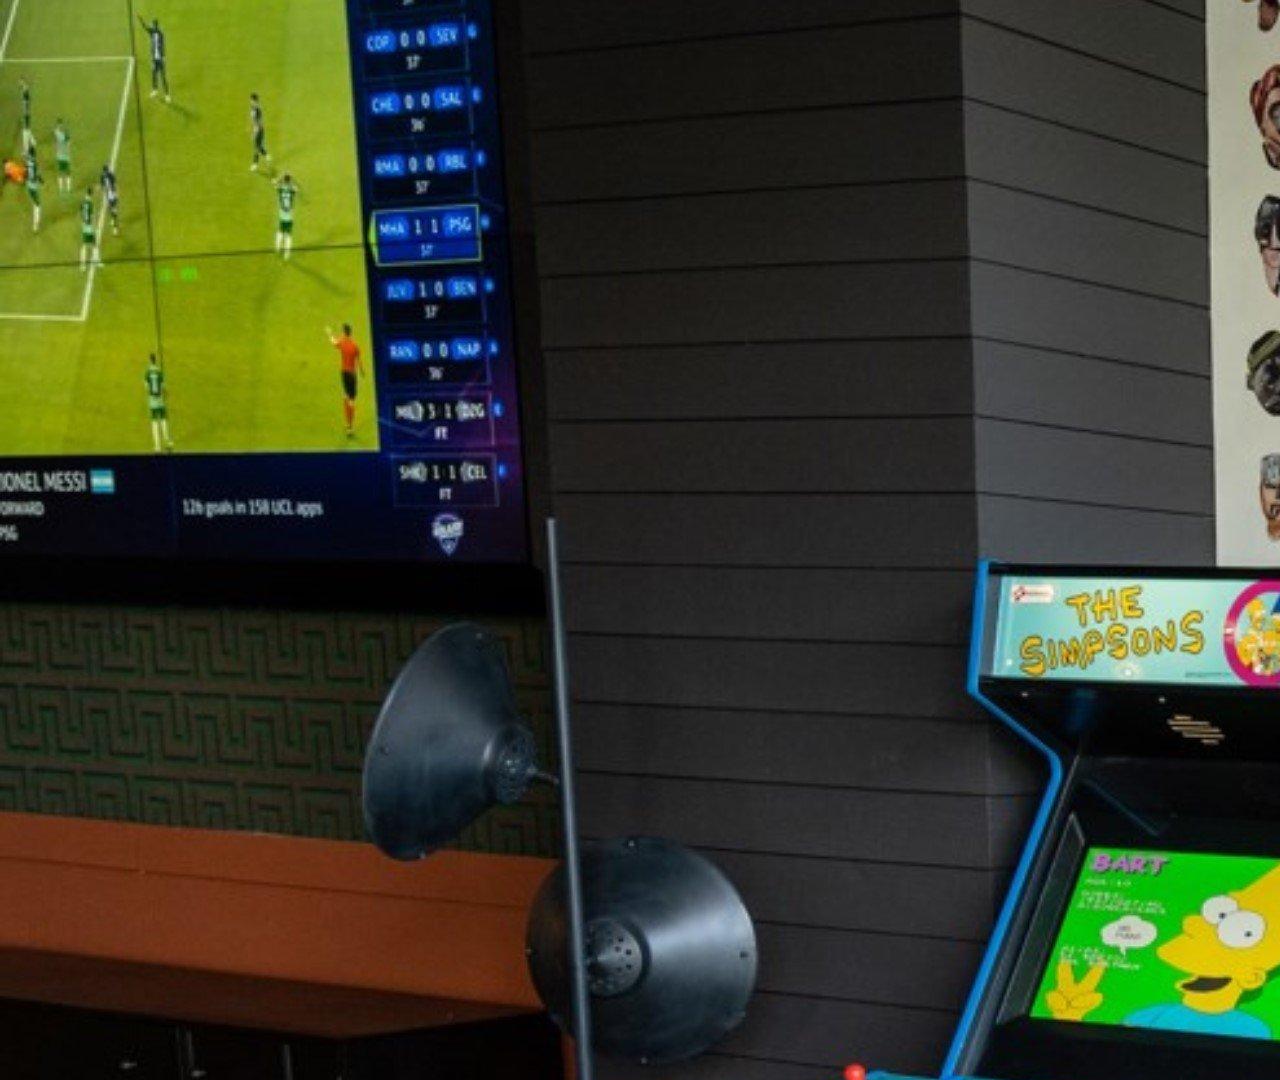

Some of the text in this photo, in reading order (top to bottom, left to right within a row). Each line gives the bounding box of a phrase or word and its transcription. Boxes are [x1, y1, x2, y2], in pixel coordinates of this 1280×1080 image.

[400, 31, 409, 47] 0
[416, 30, 425, 46] 0
[404, 94, 413, 110] 0
[421, 93, 430, 108] 0
[408, 157, 417, 172] 0
[426, 155, 435, 171] 0
[414, 219, 422, 234] 1
[431, 219, 438, 234] 1
[419, 281, 427, 297] 1
[434, 281, 443, 296] 0
[423, 342, 432, 358] 0
[439, 341, 448, 357] 0
[433, 464, 440, 479] 1
[449, 464, 456, 479] 1
[0, 471, 87, 492] IONEL MESSI
[0, 500, 44, 515] ORWARD
[206, 499, 233, 518] goals
[235, 499, 247, 514] in
[271, 498, 294, 515] UCL
[297, 502, 324, 518] apps
[1065, 584, 1145, 627] THE
[1019, 609, 1205, 677] SIMPSONS
[1094, 854, 1169, 877] BART
